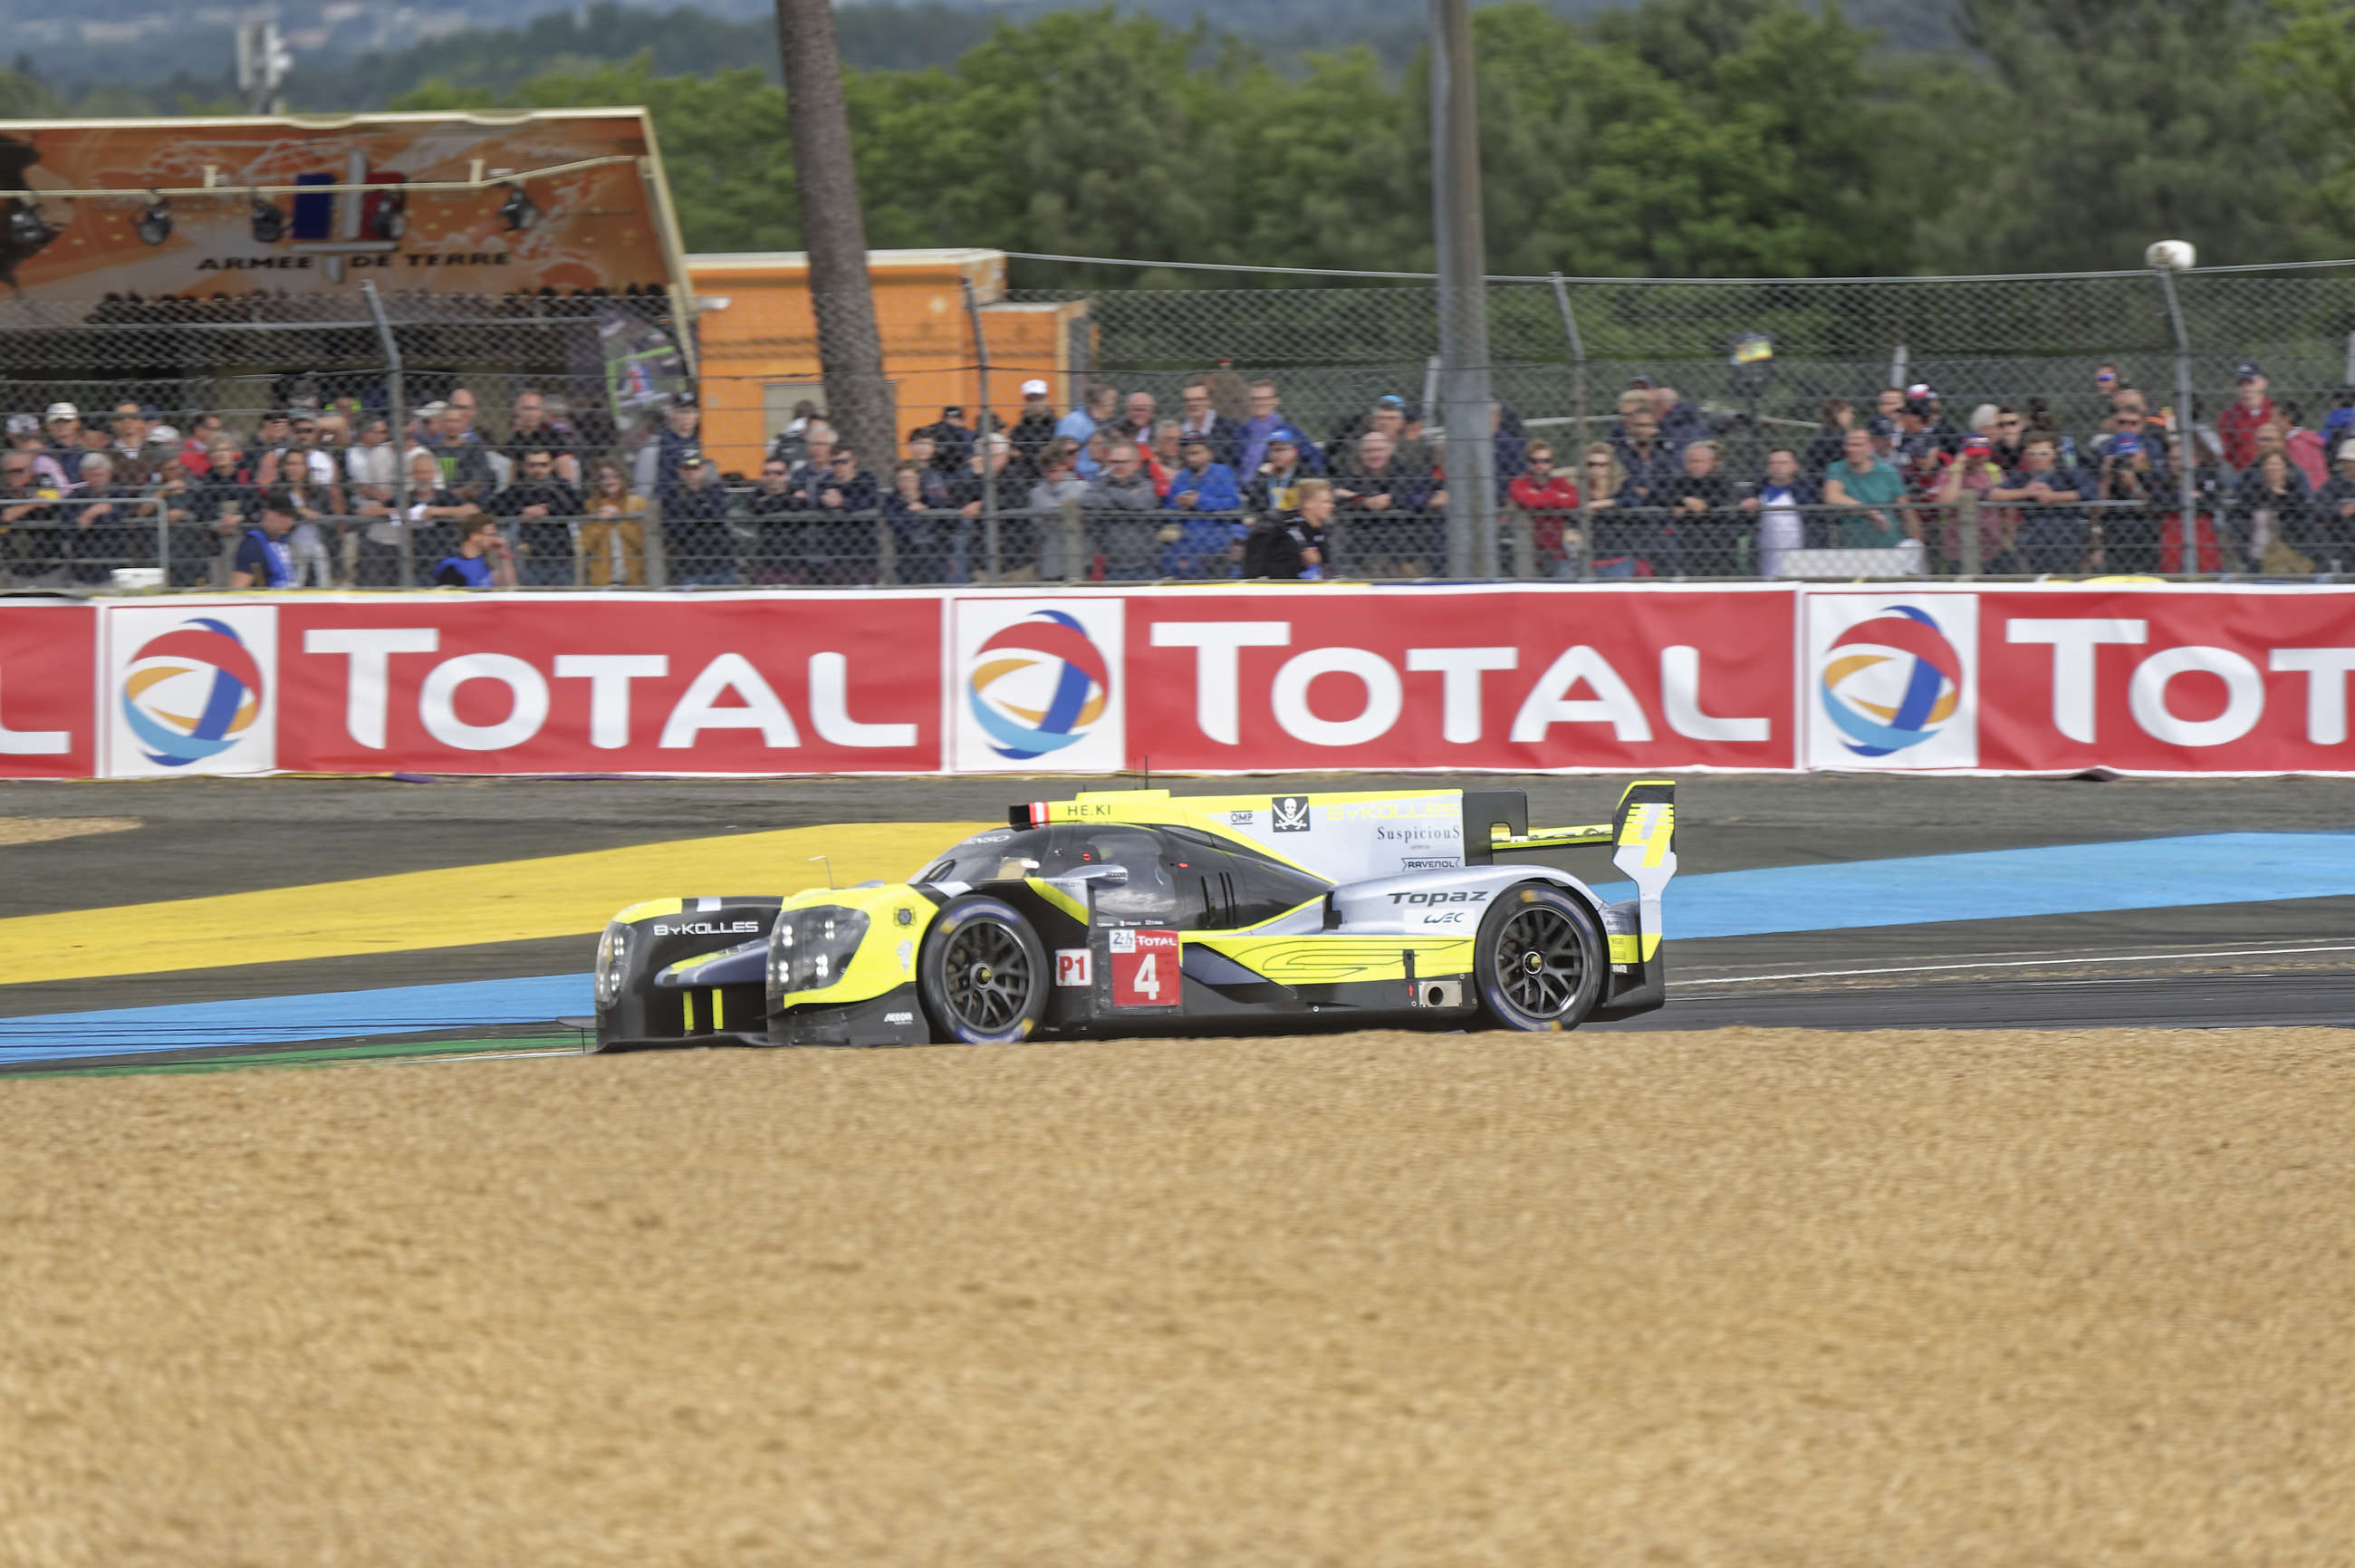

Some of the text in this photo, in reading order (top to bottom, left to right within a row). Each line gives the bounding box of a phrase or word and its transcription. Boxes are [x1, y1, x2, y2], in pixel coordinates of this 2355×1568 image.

[351, 254, 392, 268] DE
[406, 252, 511, 267] TERRE
[304, 628, 918, 751] TOTAL
[1149, 620, 1771, 747] TOTAL
[2005, 618, 2355, 747] TOT
[1067, 803, 1112, 816] HE.KI
[1231, 813, 1254, 823] OMP
[1407, 860, 1456, 870] RAVENOL
[1423, 912, 1465, 924] WEC
[1136, 935, 1178, 947] TOTAL
[1059, 956, 1085, 981] P1
[1133, 953, 1160, 1001] 4
